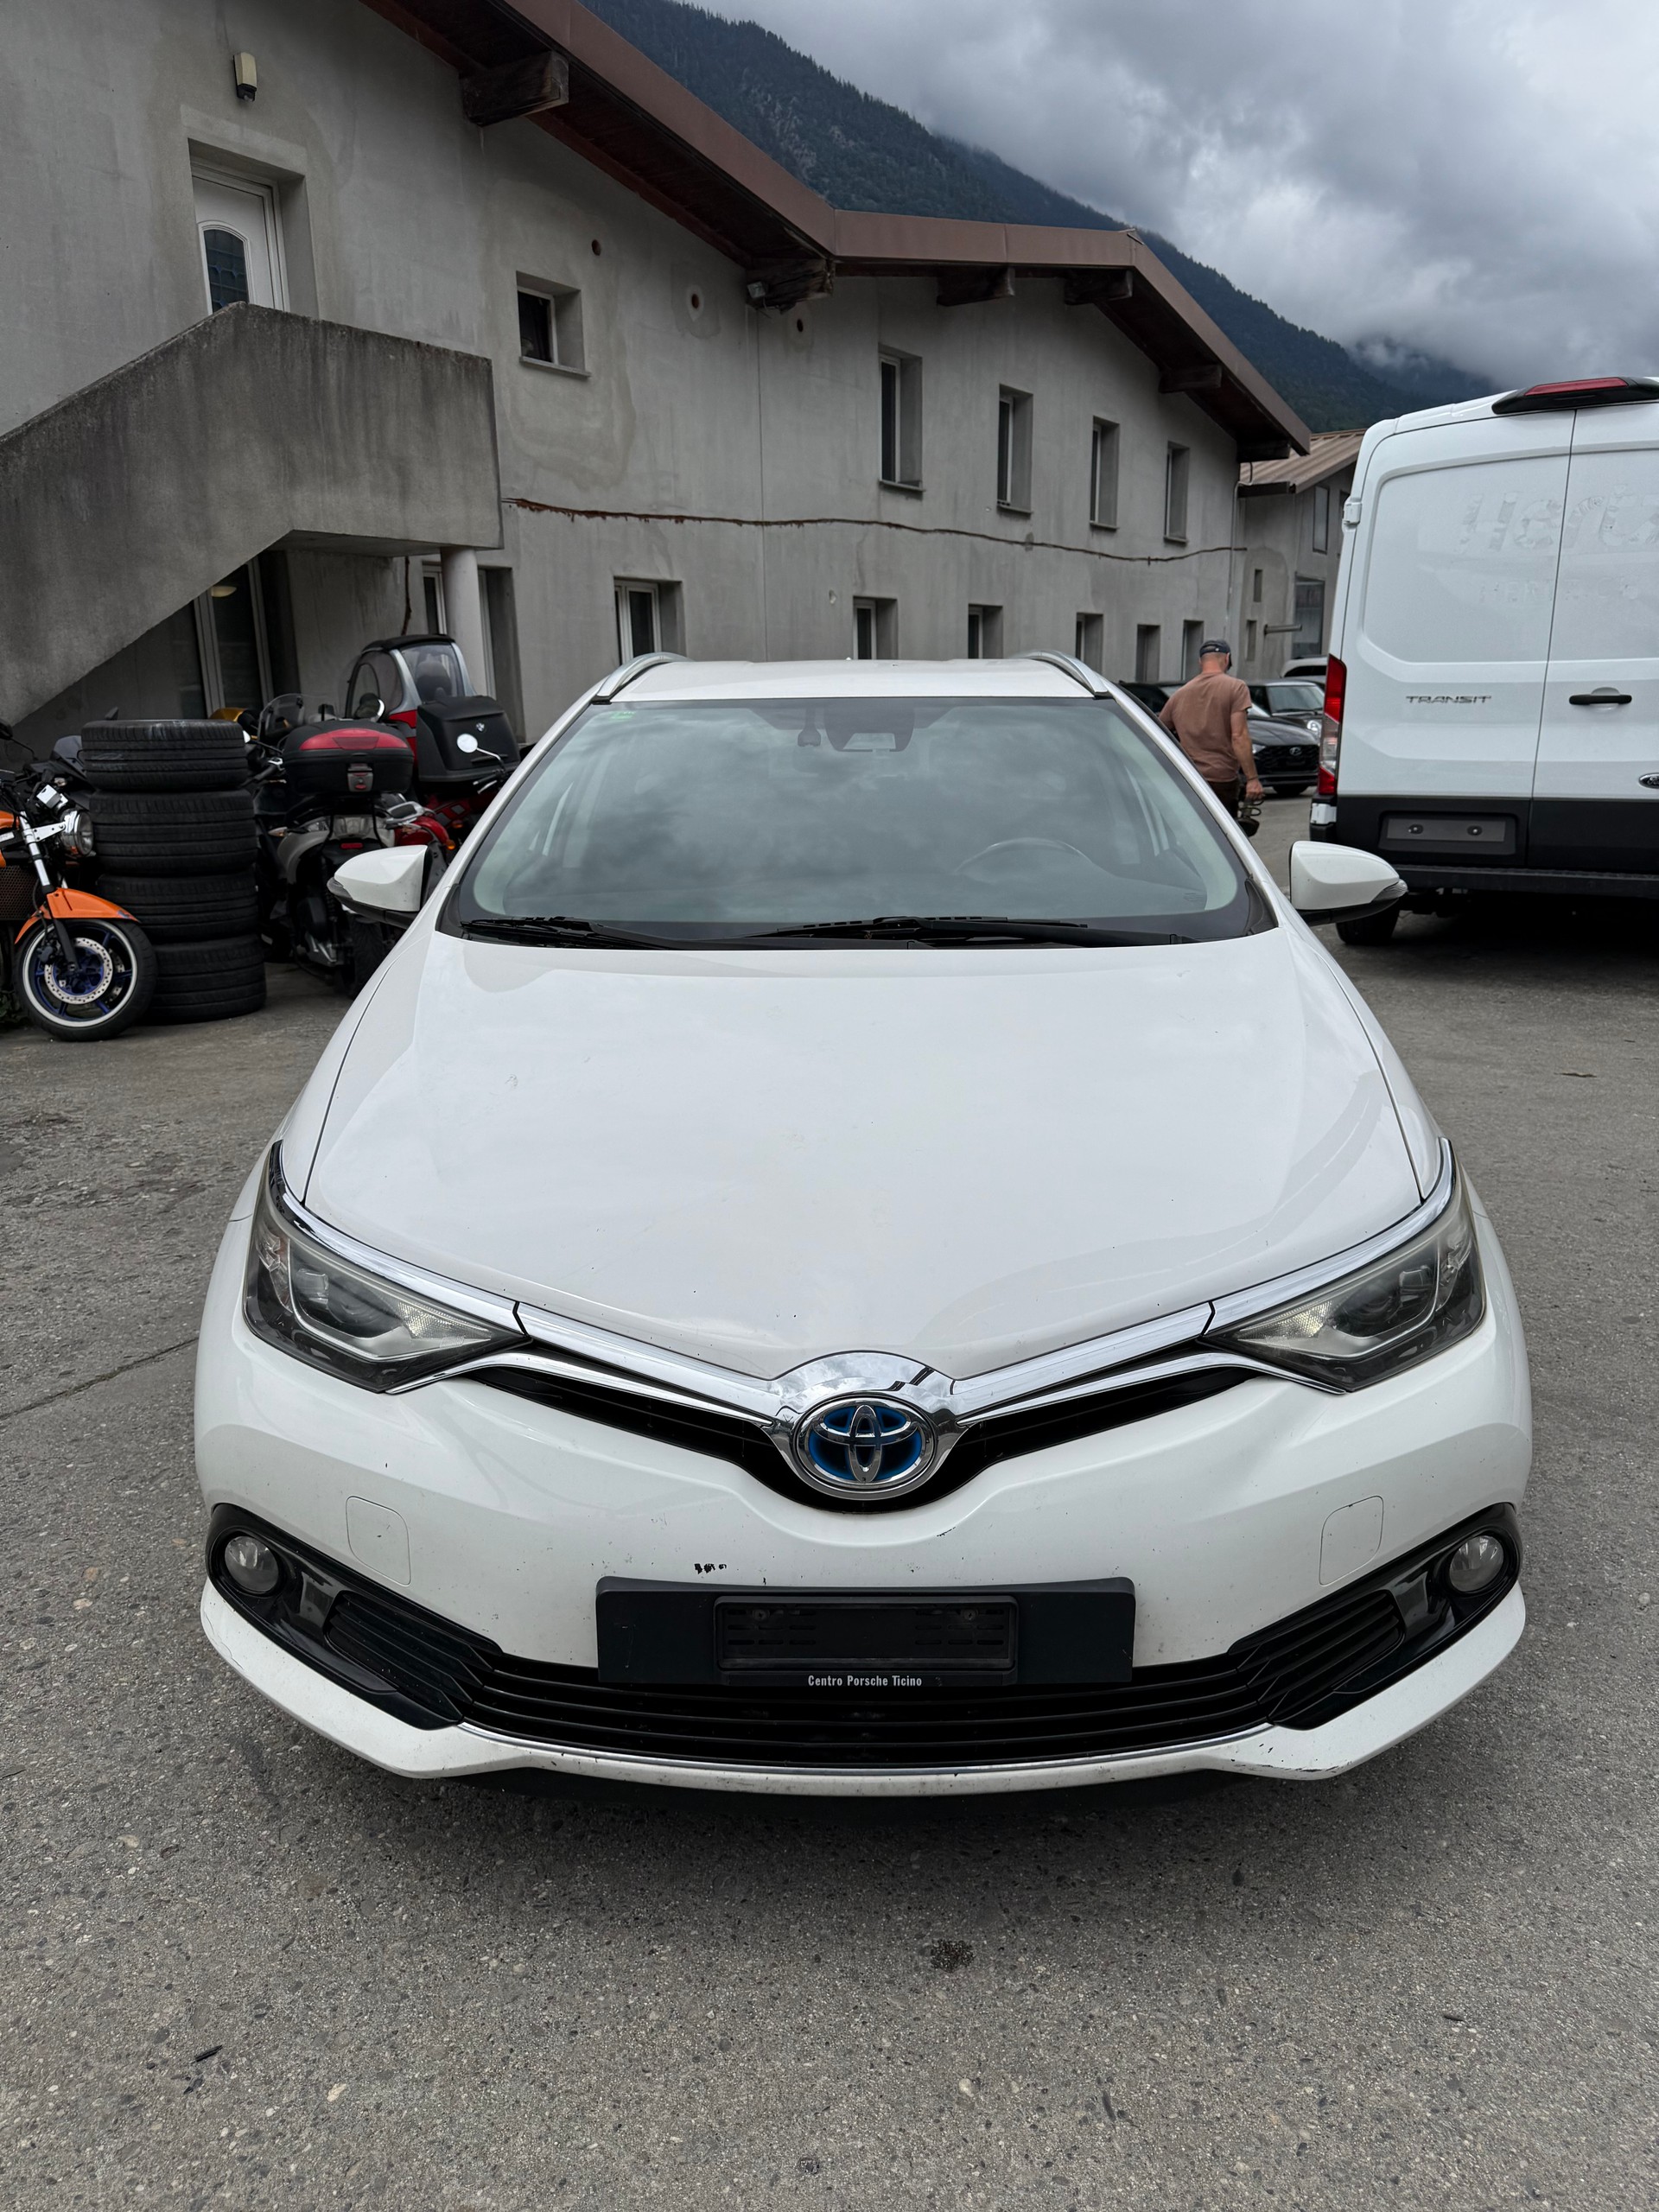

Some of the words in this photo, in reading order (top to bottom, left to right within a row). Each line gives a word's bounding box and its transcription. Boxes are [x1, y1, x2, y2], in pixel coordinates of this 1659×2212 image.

[1406, 696, 1492, 704] TRANSIT
[808, 1675, 843, 1687] Centro
[847, 1675, 888, 1687] Porsche
[892, 1675, 922, 1687] Ticino
